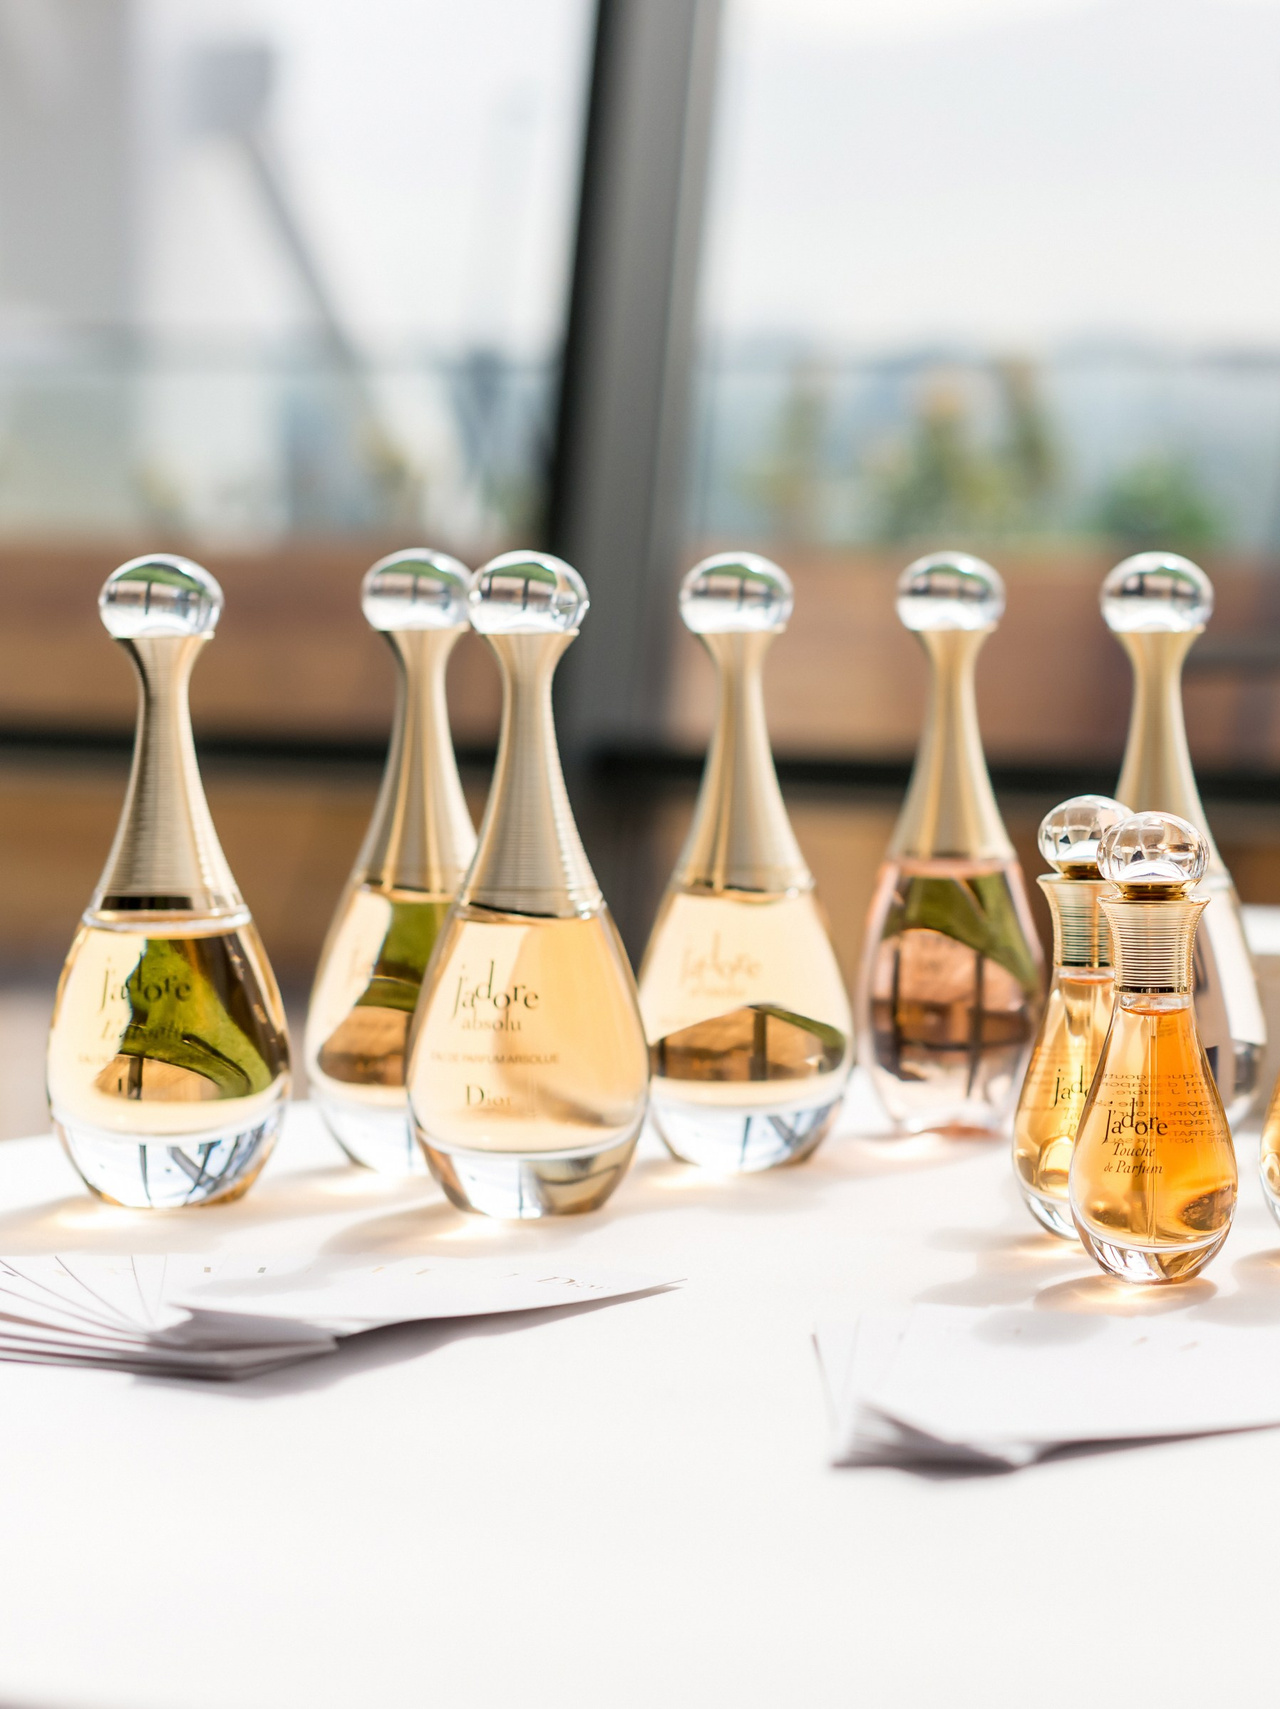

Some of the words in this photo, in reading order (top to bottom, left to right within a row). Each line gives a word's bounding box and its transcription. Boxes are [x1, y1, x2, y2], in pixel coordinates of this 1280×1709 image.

[453, 960, 539, 1018] j'adore
[461, 1011, 522, 1032] absolu
[466, 1085, 513, 1107] Dior
[1101, 1098, 1168, 1145] j'adore
[1112, 1141, 1156, 1158] Touche
[1103, 1163, 1113, 1173] de
[1115, 1160, 1163, 1177] Parfum
